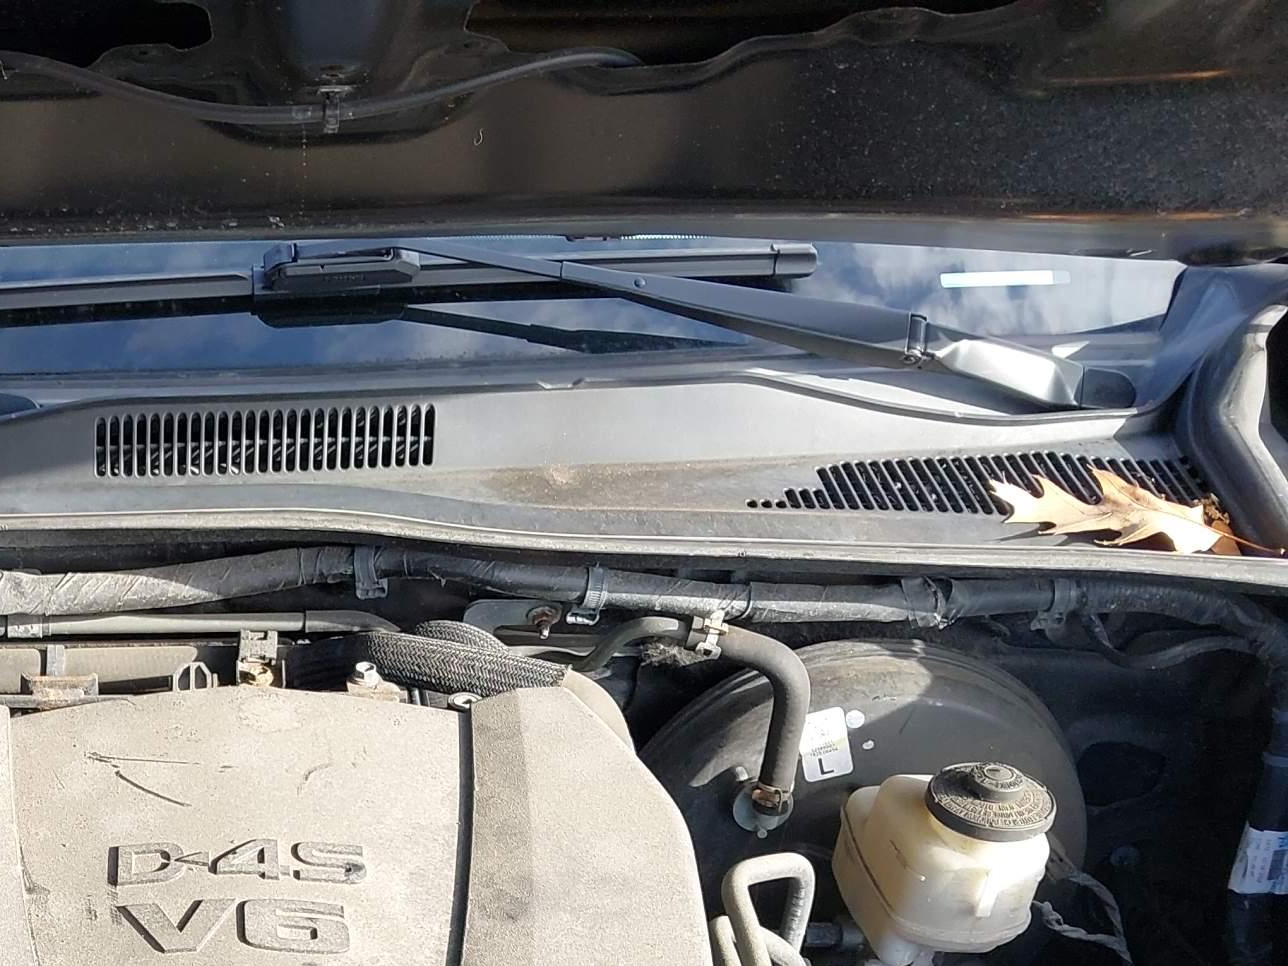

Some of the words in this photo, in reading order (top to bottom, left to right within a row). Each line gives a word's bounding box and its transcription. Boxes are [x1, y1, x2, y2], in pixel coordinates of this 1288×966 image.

[817, 757, 835, 775] L
[106, 838, 367, 887] D-4S
[114, 898, 351, 954] V6
